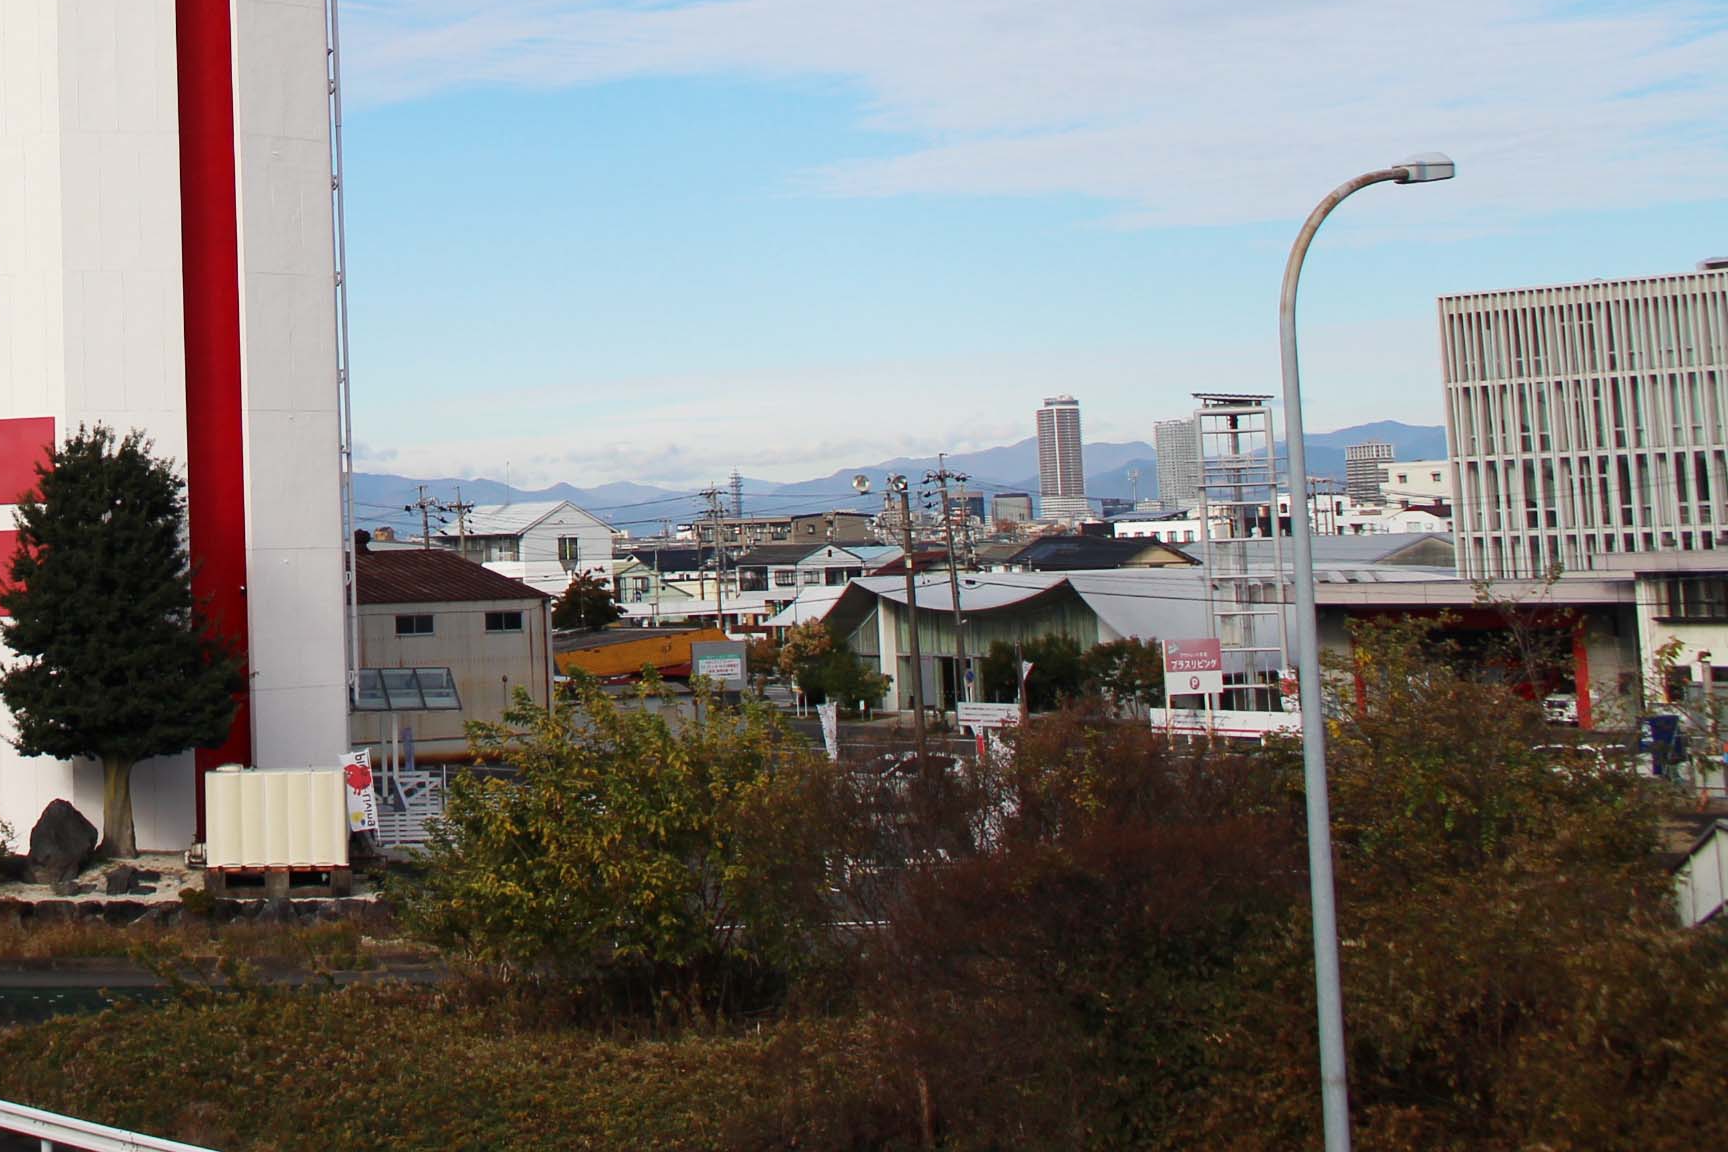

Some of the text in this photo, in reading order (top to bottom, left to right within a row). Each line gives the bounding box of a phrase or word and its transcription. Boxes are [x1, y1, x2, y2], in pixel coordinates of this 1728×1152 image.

[1171, 659, 1216, 668] プラスリビング
